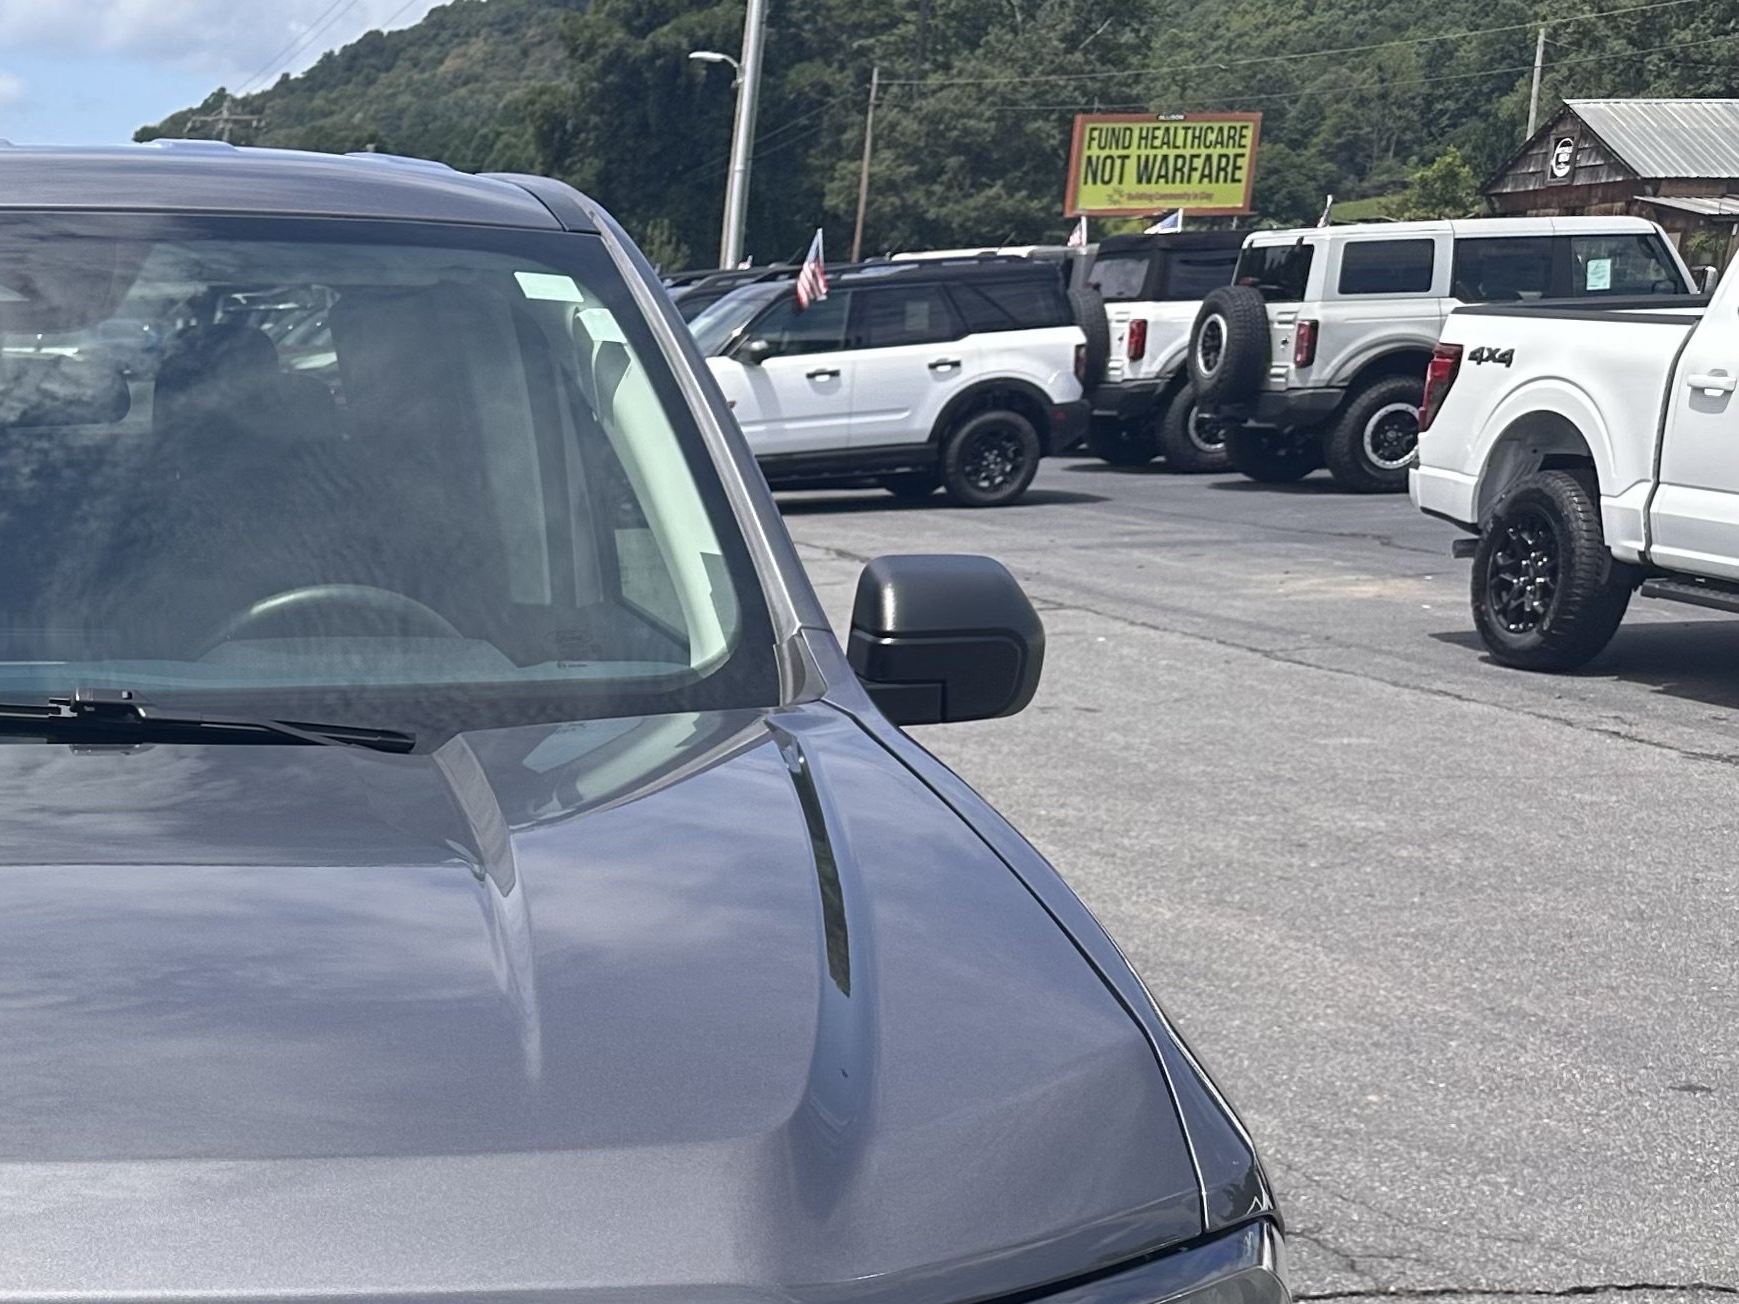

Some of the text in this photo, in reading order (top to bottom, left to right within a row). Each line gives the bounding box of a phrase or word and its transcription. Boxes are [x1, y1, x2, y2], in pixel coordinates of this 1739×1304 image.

[1087, 125, 1249, 150] FUND HEALTHCARE
[1083, 153, 1246, 186] NOT WARFARE
